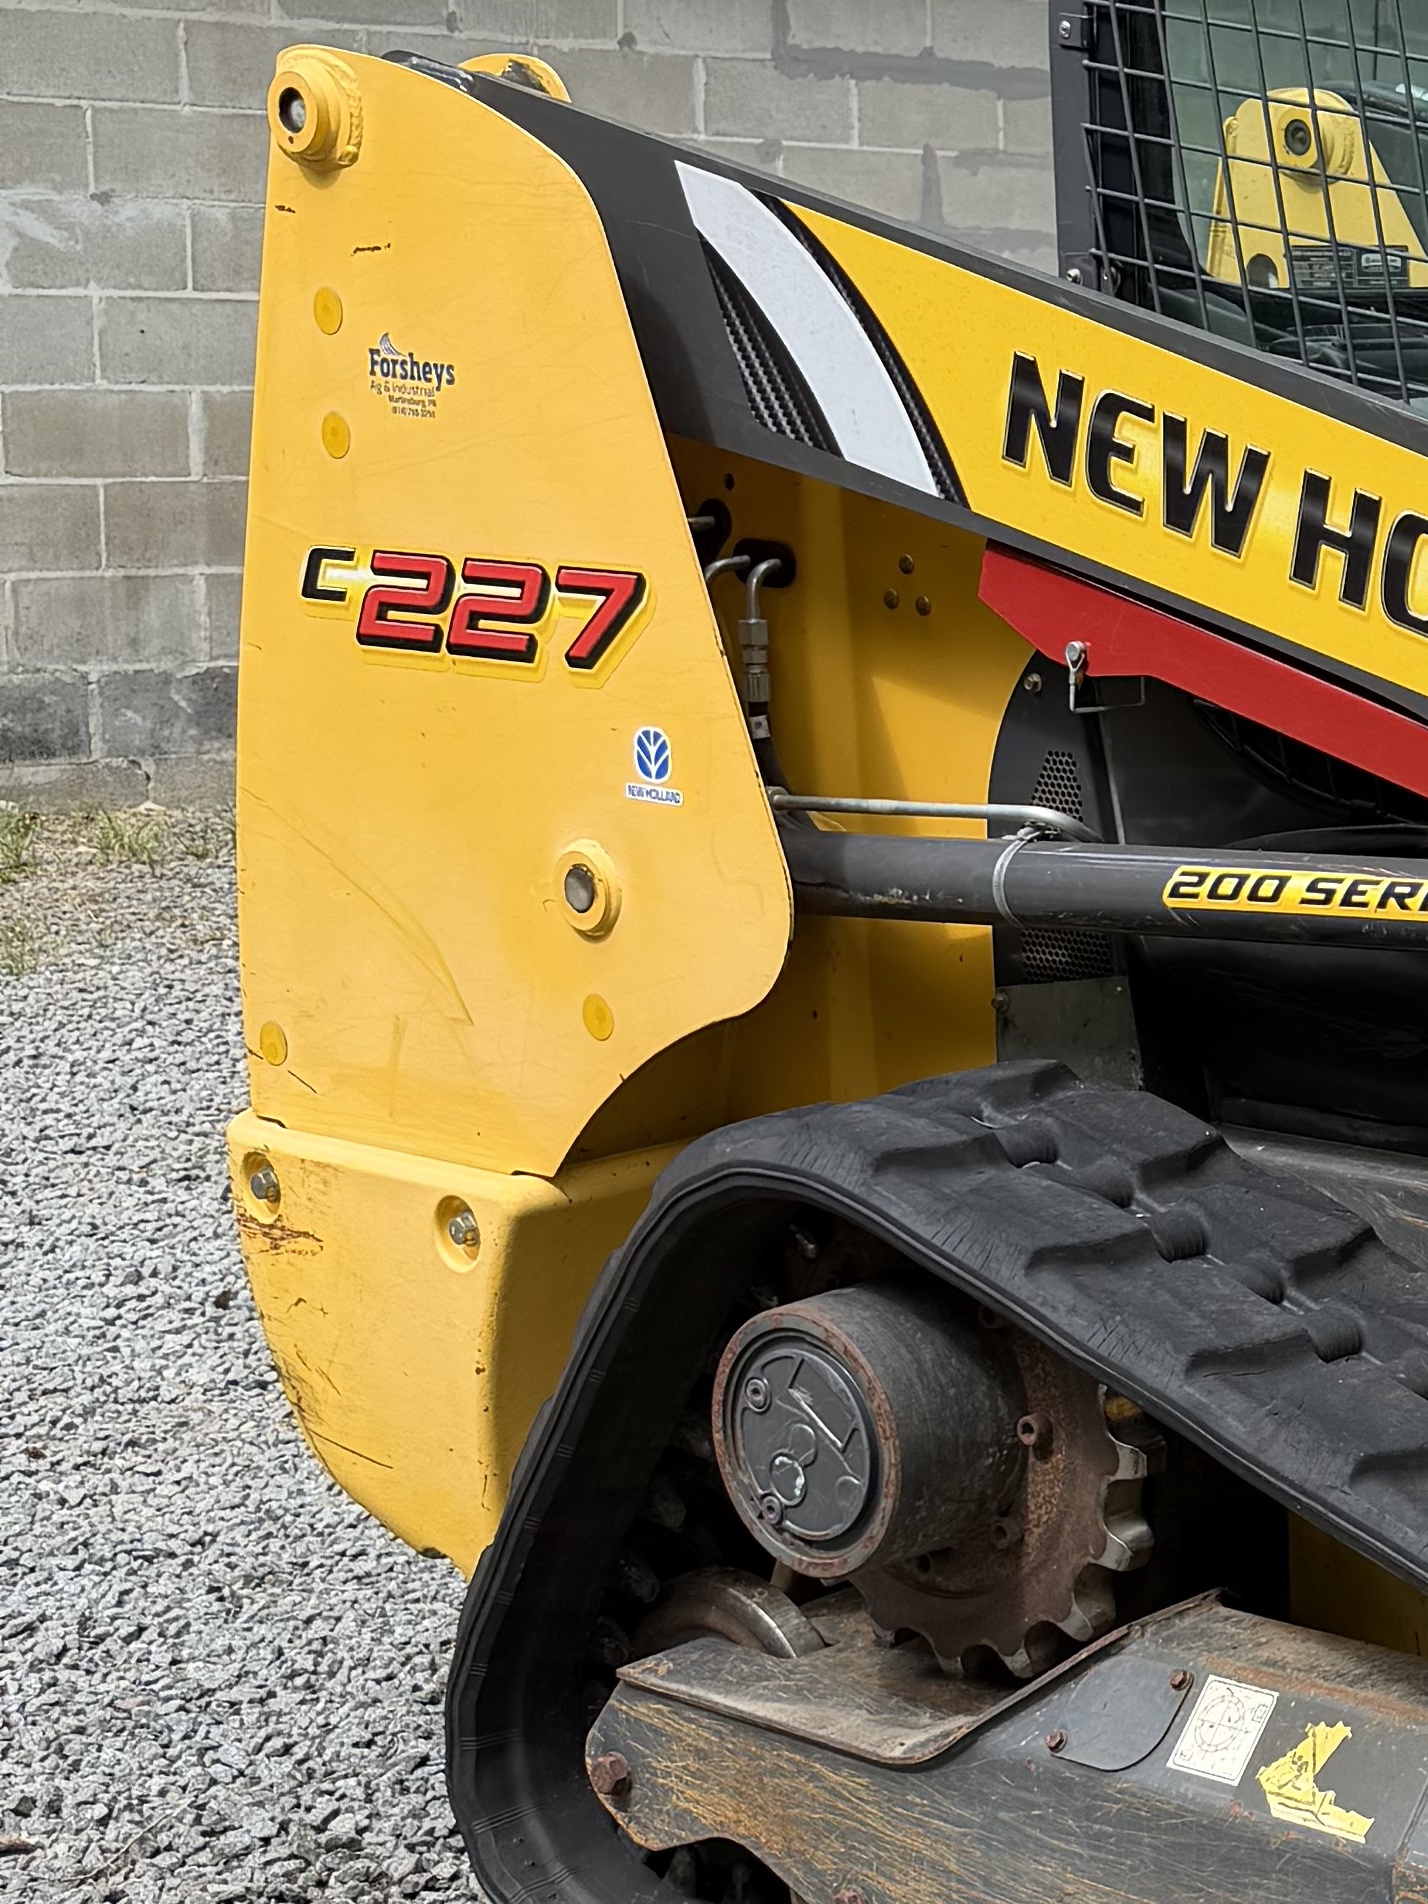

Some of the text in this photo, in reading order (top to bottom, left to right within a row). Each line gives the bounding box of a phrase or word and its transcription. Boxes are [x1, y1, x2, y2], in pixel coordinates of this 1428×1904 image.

[368, 348, 455, 392] Forsheys
[1002, 349, 1271, 559] NEW
[645, 788, 681, 804] HOLLAND
[1167, 870, 1292, 902] 200
